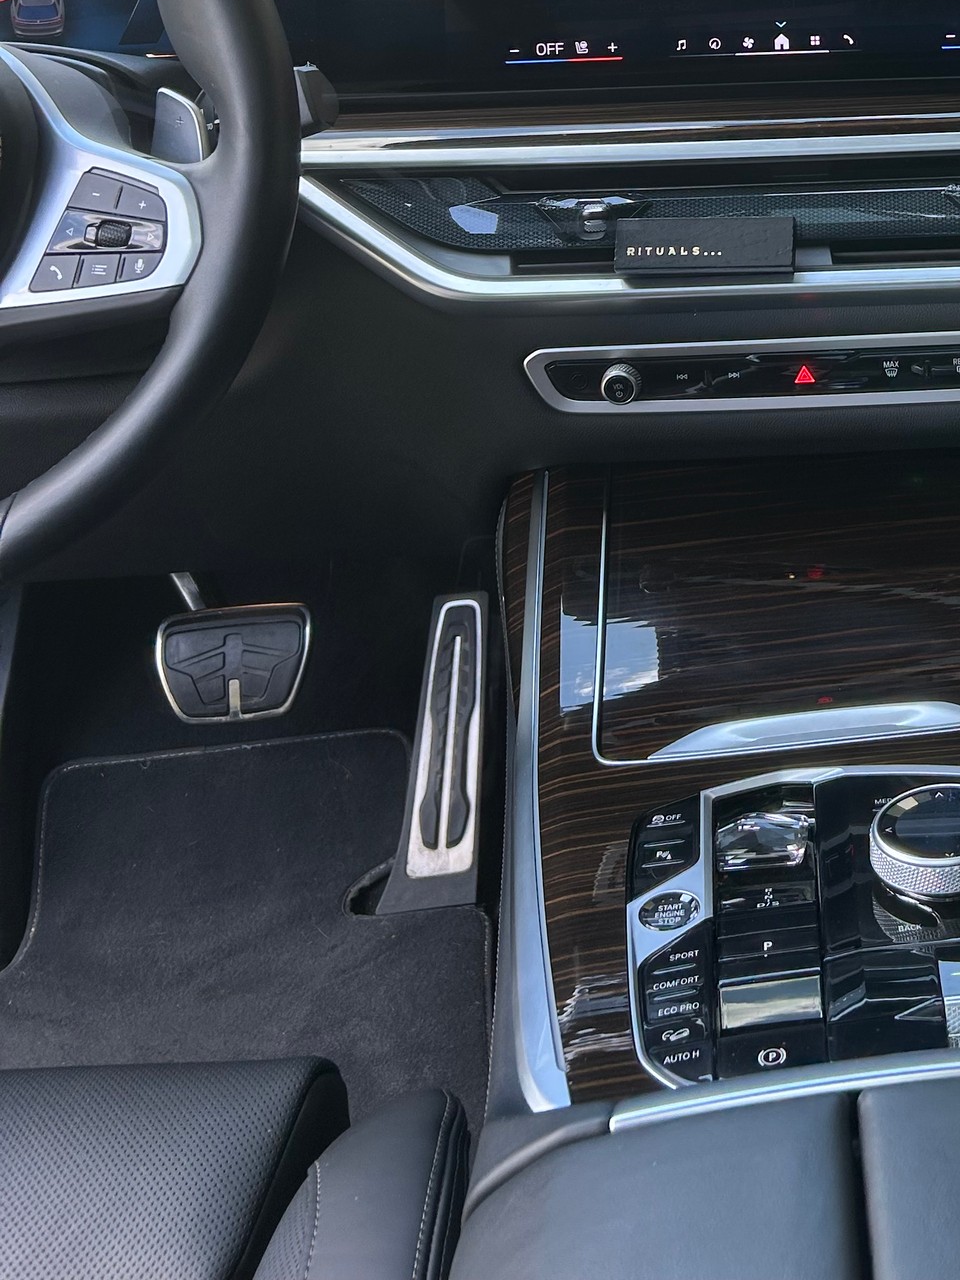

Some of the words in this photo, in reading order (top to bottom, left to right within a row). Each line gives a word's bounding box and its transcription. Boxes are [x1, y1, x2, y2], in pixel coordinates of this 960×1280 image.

[535, 42, 565, 56] OFF
[626, 246, 722, 256] RITUALS...
[883, 360, 900, 369] MAX
[665, 813, 682, 821] OFF
[657, 902, 683, 912] START
[654, 910, 685, 919] ENGINE
[658, 916, 682, 924] STOP
[897, 923, 923, 933] BACK
[763, 941, 773, 951] P
[669, 949, 700, 962] SPORT
[652, 975, 700, 991] COMFORT
[657, 1005, 678, 1017] ECO
[679, 1002, 700, 1013] PRO
[663, 1052, 690, 1065] AUTO
[691, 1050, 700, 1059] H
